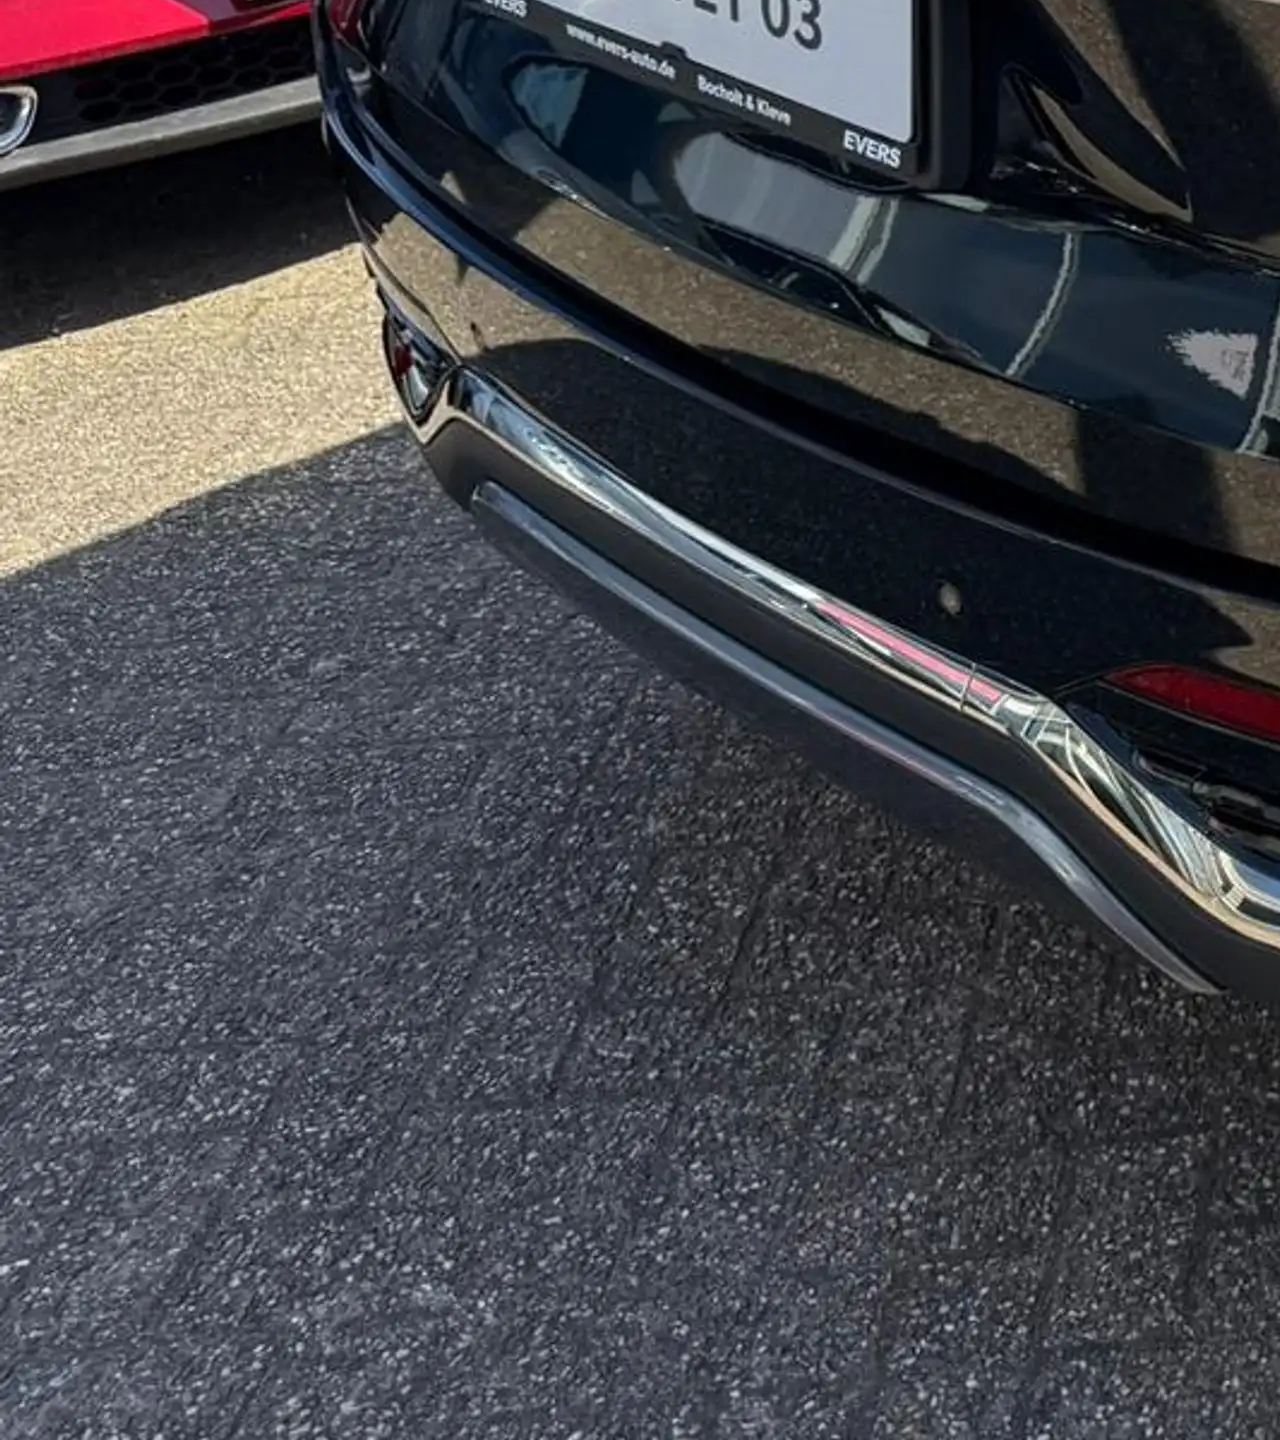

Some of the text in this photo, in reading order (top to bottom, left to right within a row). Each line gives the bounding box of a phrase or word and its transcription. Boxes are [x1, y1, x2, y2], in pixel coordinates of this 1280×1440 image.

[565, 23, 677, 80] www.evers-auto.de
[697, 74, 744, 108] Bocholt
[756, 98, 792, 127] Kleve
[843, 129, 901, 170] EVERS
